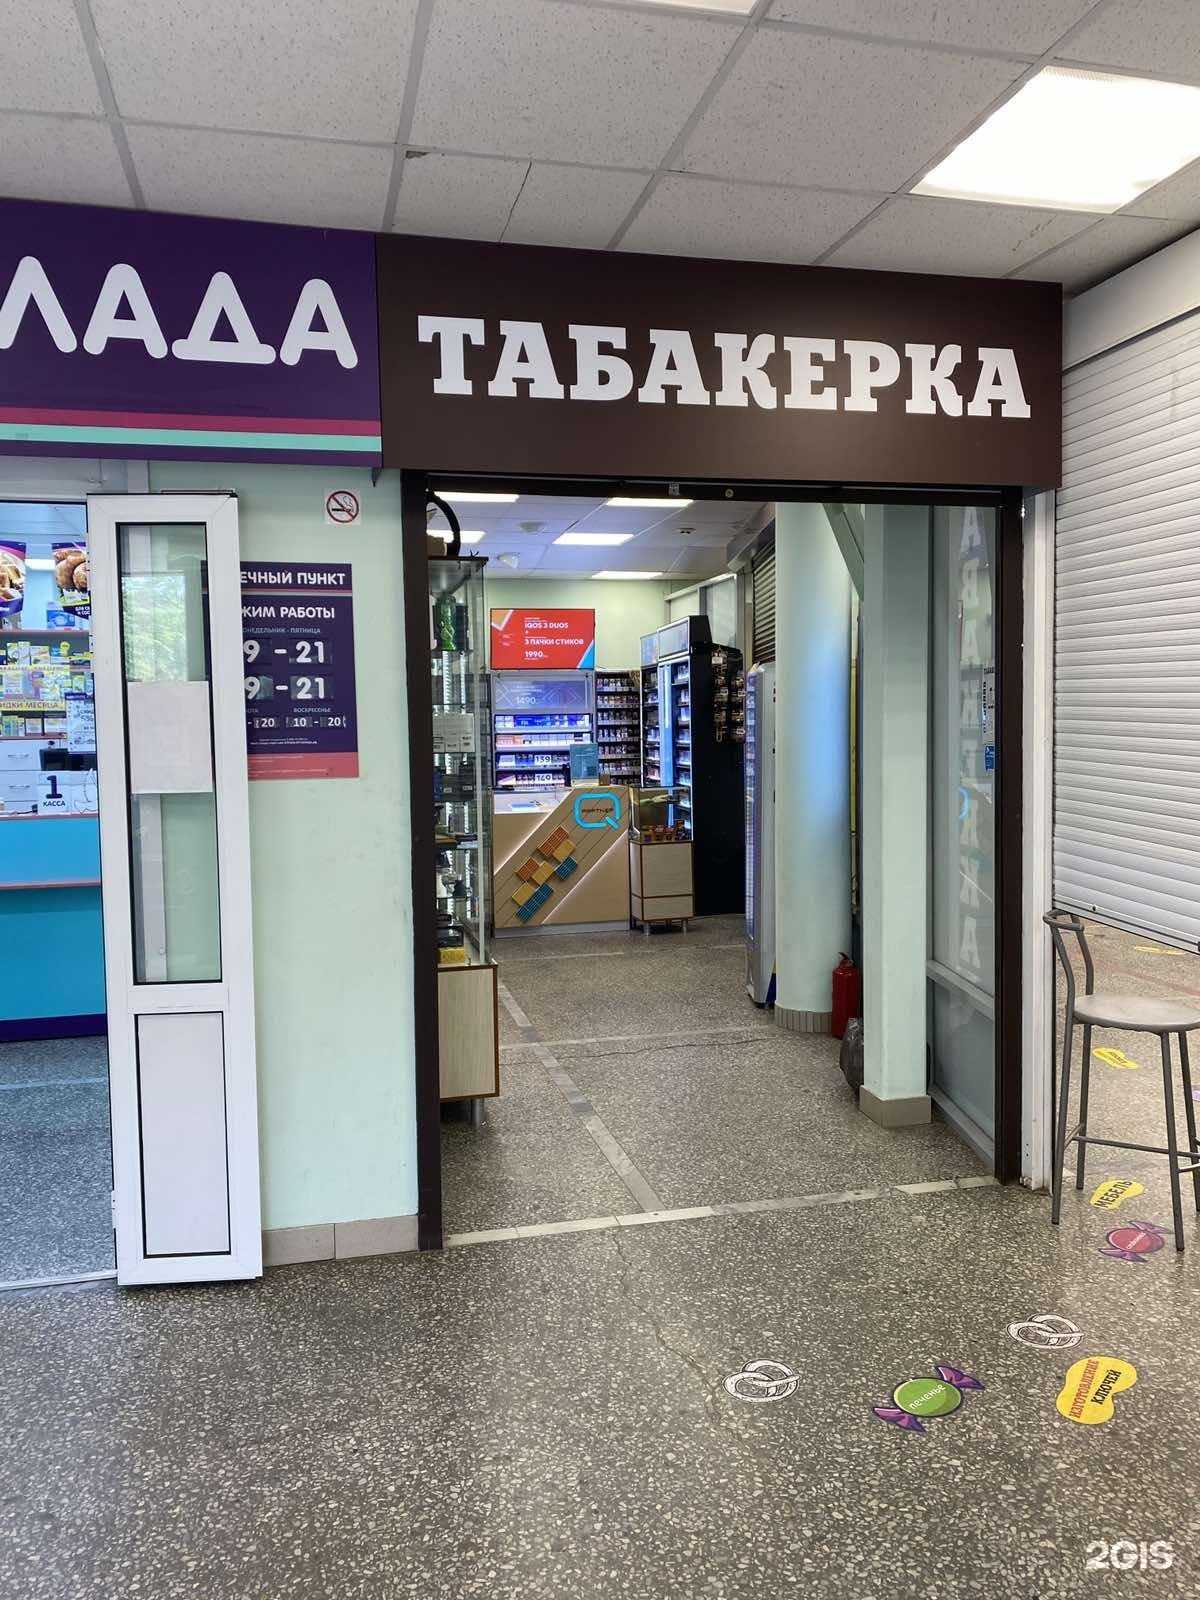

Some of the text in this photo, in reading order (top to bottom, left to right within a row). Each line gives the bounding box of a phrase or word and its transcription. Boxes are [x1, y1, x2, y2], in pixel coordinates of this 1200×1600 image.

[0, 255, 358, 369] ЛАДА
[417, 315, 1032, 418] ТАБАКЕРКА
[240, 570, 346, 585] ЕЧНЫЙ ПУНКТ
[280, 606, 335, 619] РАБОТЫ
[243, 640, 260, 663] 9
[296, 641, 325, 663] 21
[244, 676, 260, 699] 9
[296, 677, 325, 699] 21
[261, 718, 275, 727] 20
[293, 717, 307, 727] 10
[328, 717, 341, 727] 20
[46, 775, 63, 799] 1
[1094, 1179, 1133, 1209] МЕБЕЛЬ
[908, 1384, 946, 1410] печенье
[1069, 1359, 1099, 1418] ИЗГОТОВЛЕНИЕ
[1090, 1369, 1122, 1405] КЛЮЧЕЙ
